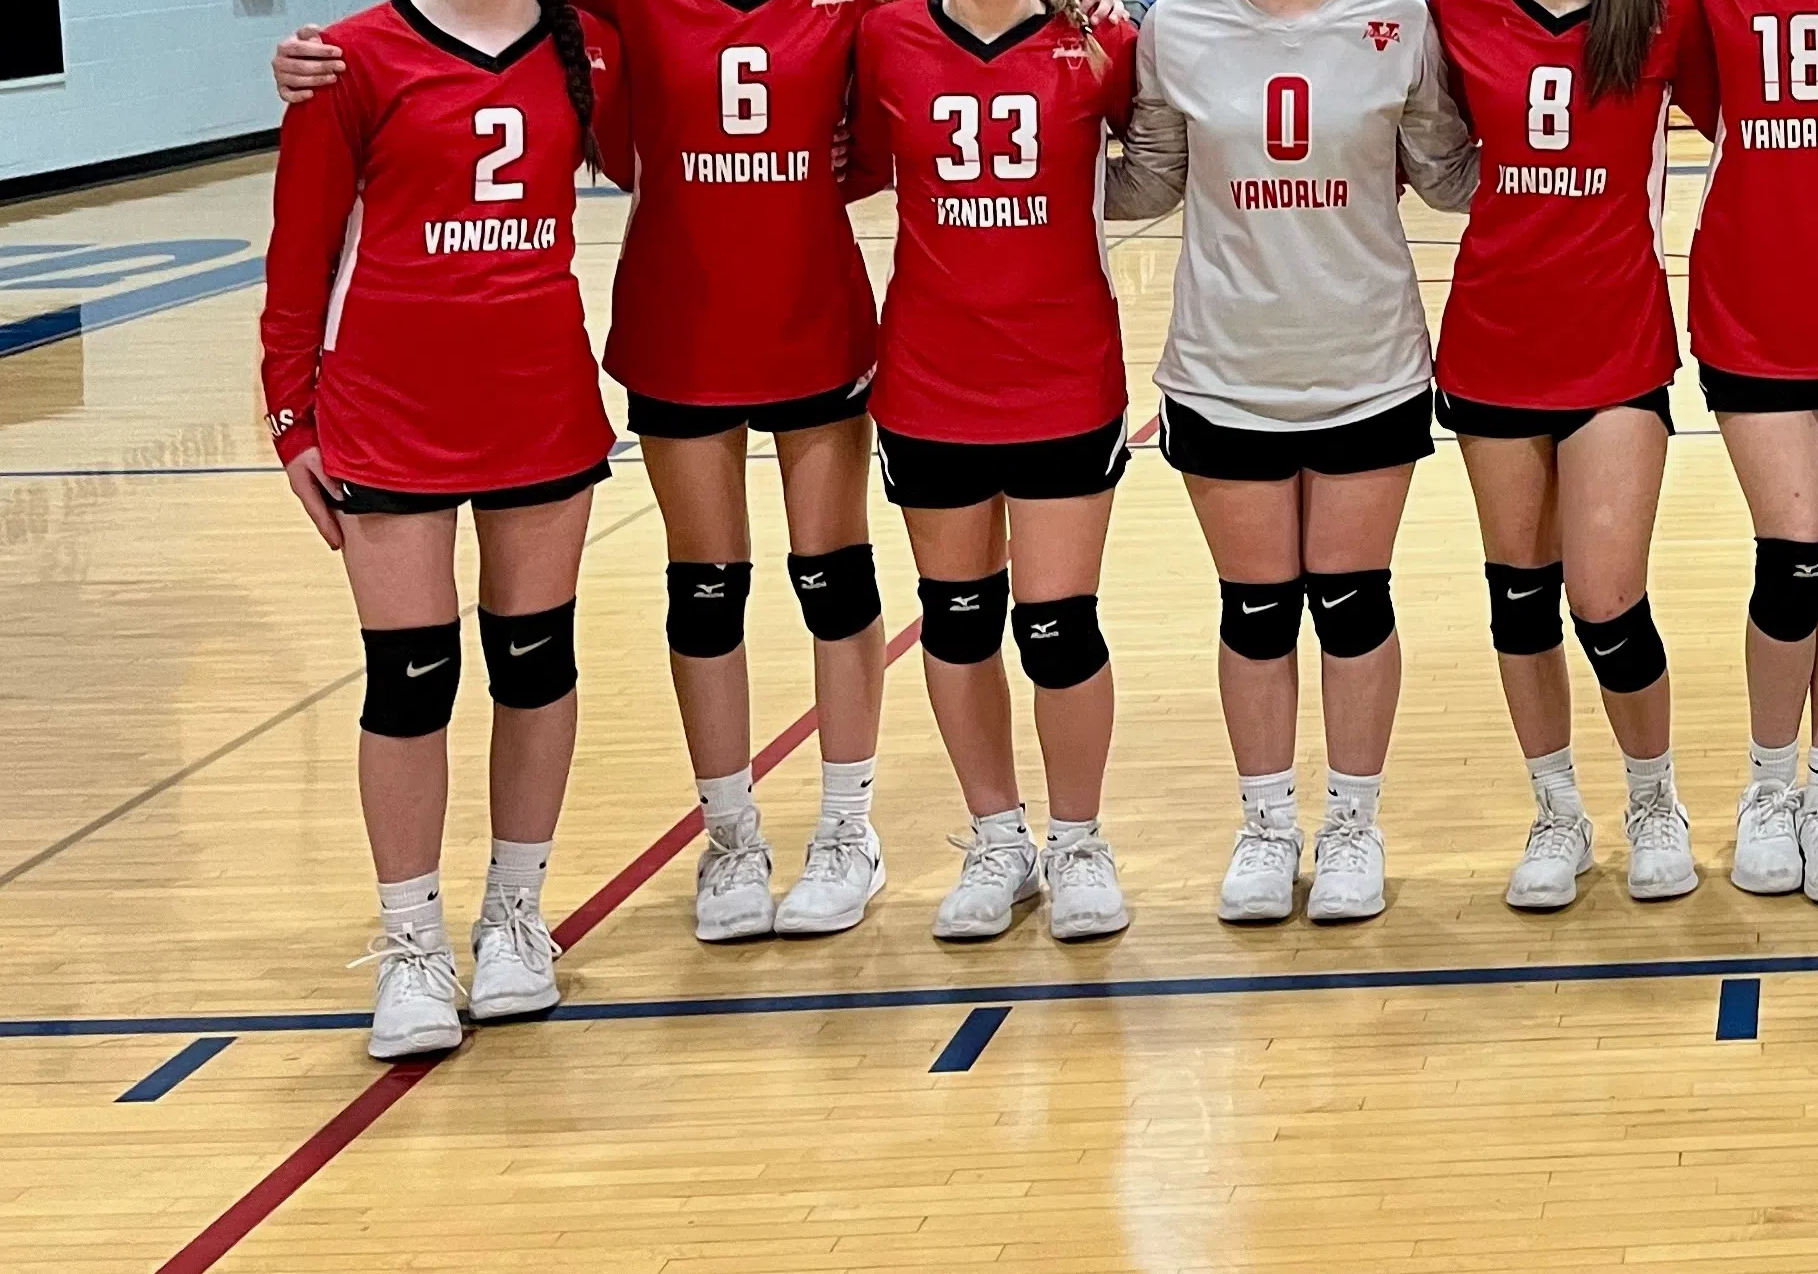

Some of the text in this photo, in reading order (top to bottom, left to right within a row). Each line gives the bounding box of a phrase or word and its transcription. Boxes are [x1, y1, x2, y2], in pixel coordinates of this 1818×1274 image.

[720, 45, 769, 135] 6
[1263, 73, 1313, 165] 0
[1527, 65, 1573, 151] 8
[473, 106, 525, 202] 2
[680, 150, 810, 183] VANDALIA
[932, 93, 1039, 182] 33
[424, 217, 557, 255] VANDALIA
[930, 195, 1048, 228] VANDALIA
[1230, 178, 1349, 211] VANDALIA
